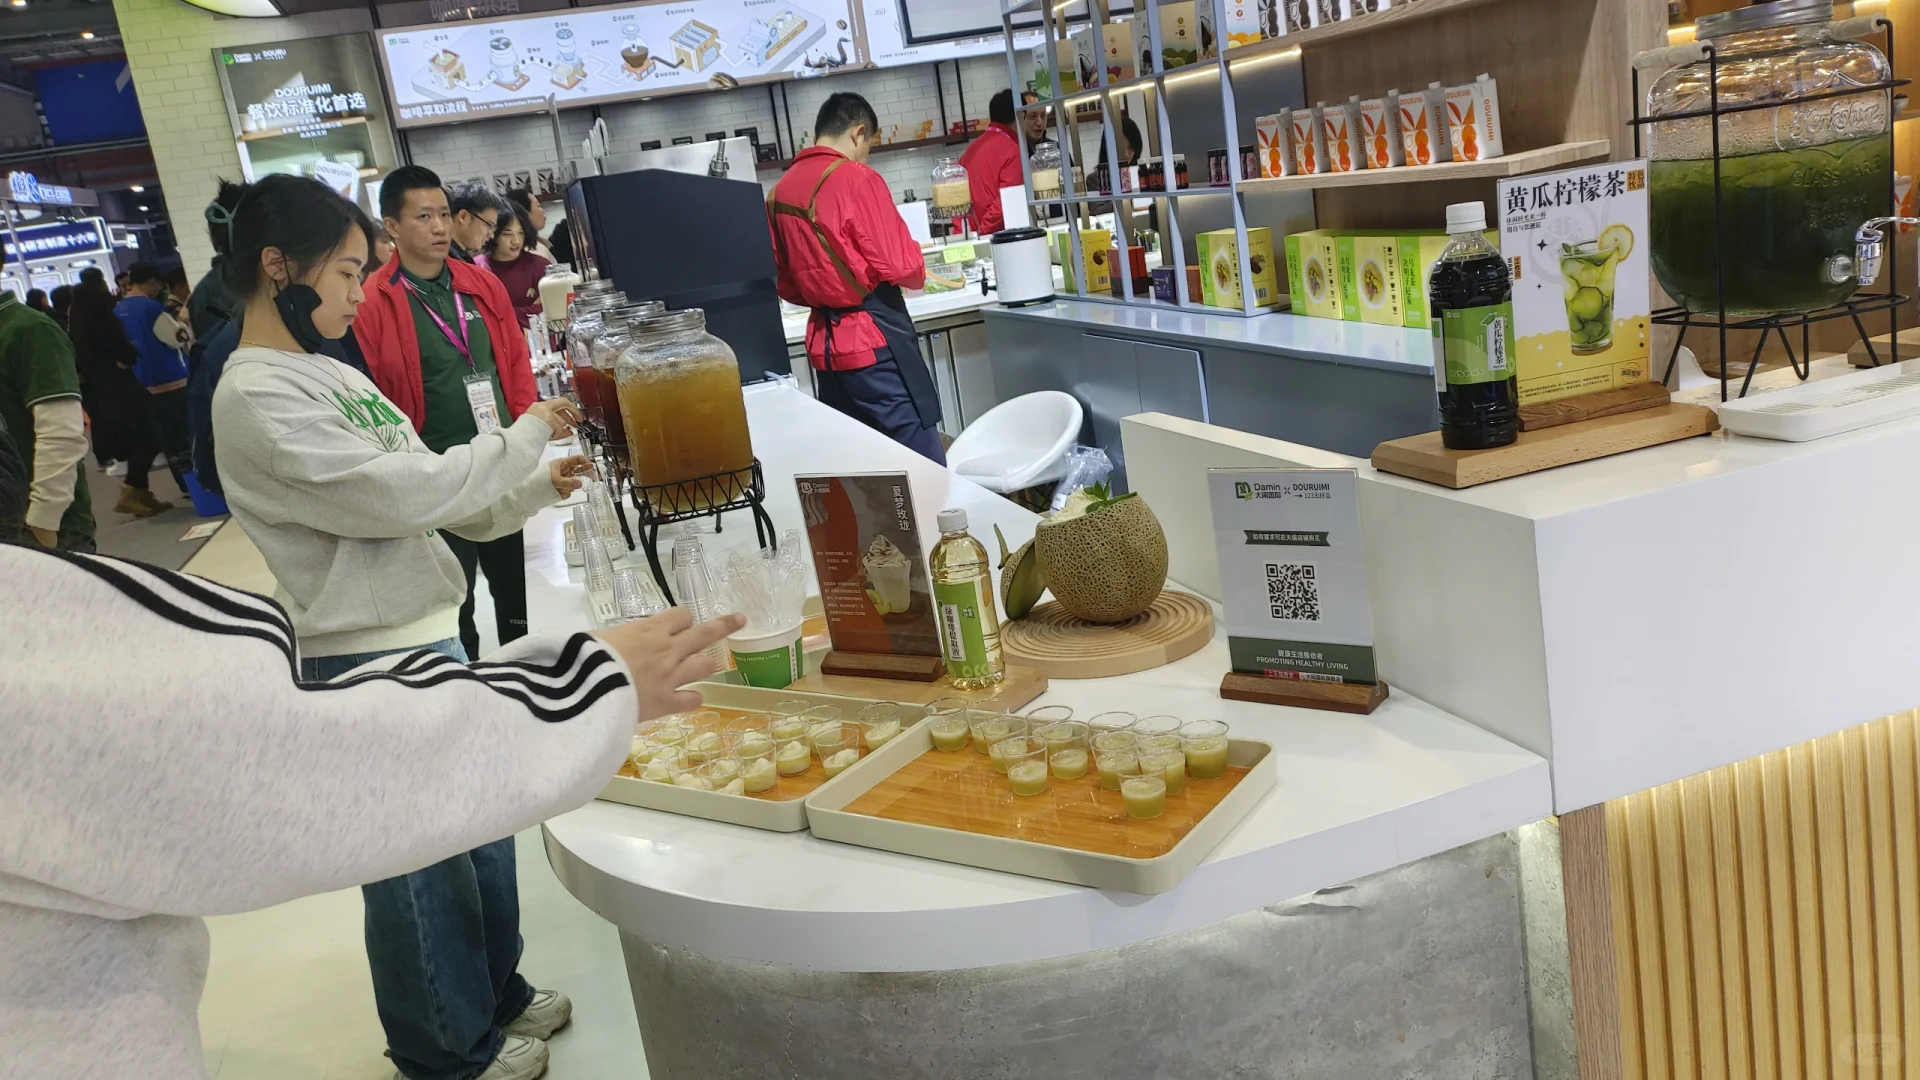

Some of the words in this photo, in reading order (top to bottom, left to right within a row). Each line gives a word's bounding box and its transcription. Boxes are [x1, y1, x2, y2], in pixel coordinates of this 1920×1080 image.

[275, 83, 332, 98] DOURUIMI
[247, 92, 367, 121] 餐饮标准化首选
[400, 101, 467, 119] 咖啡萃取流程
[1434, 105, 1445, 146] DOURUIMI
[1484, 99, 1494, 141] DOURUIMI
[316, 165, 353, 178] DOURUIMI
[1504, 169, 1625, 215] 黄瓜柠檬茶
[1506, 211, 1547, 223] 休闲时光来一杯
[1494, 319, 1504, 365] 黄瓜柠檬茶
[1254, 483, 1281, 491] Damin
[1255, 491, 1281, 499] 大闽国际
[892, 485, 910, 531] 夏梦玫珑
[1252, 533, 1321, 542] 如有需求可在天猫店铺购买
[1256, 656, 1294, 666] PROMOTING
[1295, 659, 1325, 668] HEALTHY
[1277, 649, 1323, 660] 健康生活推动者
